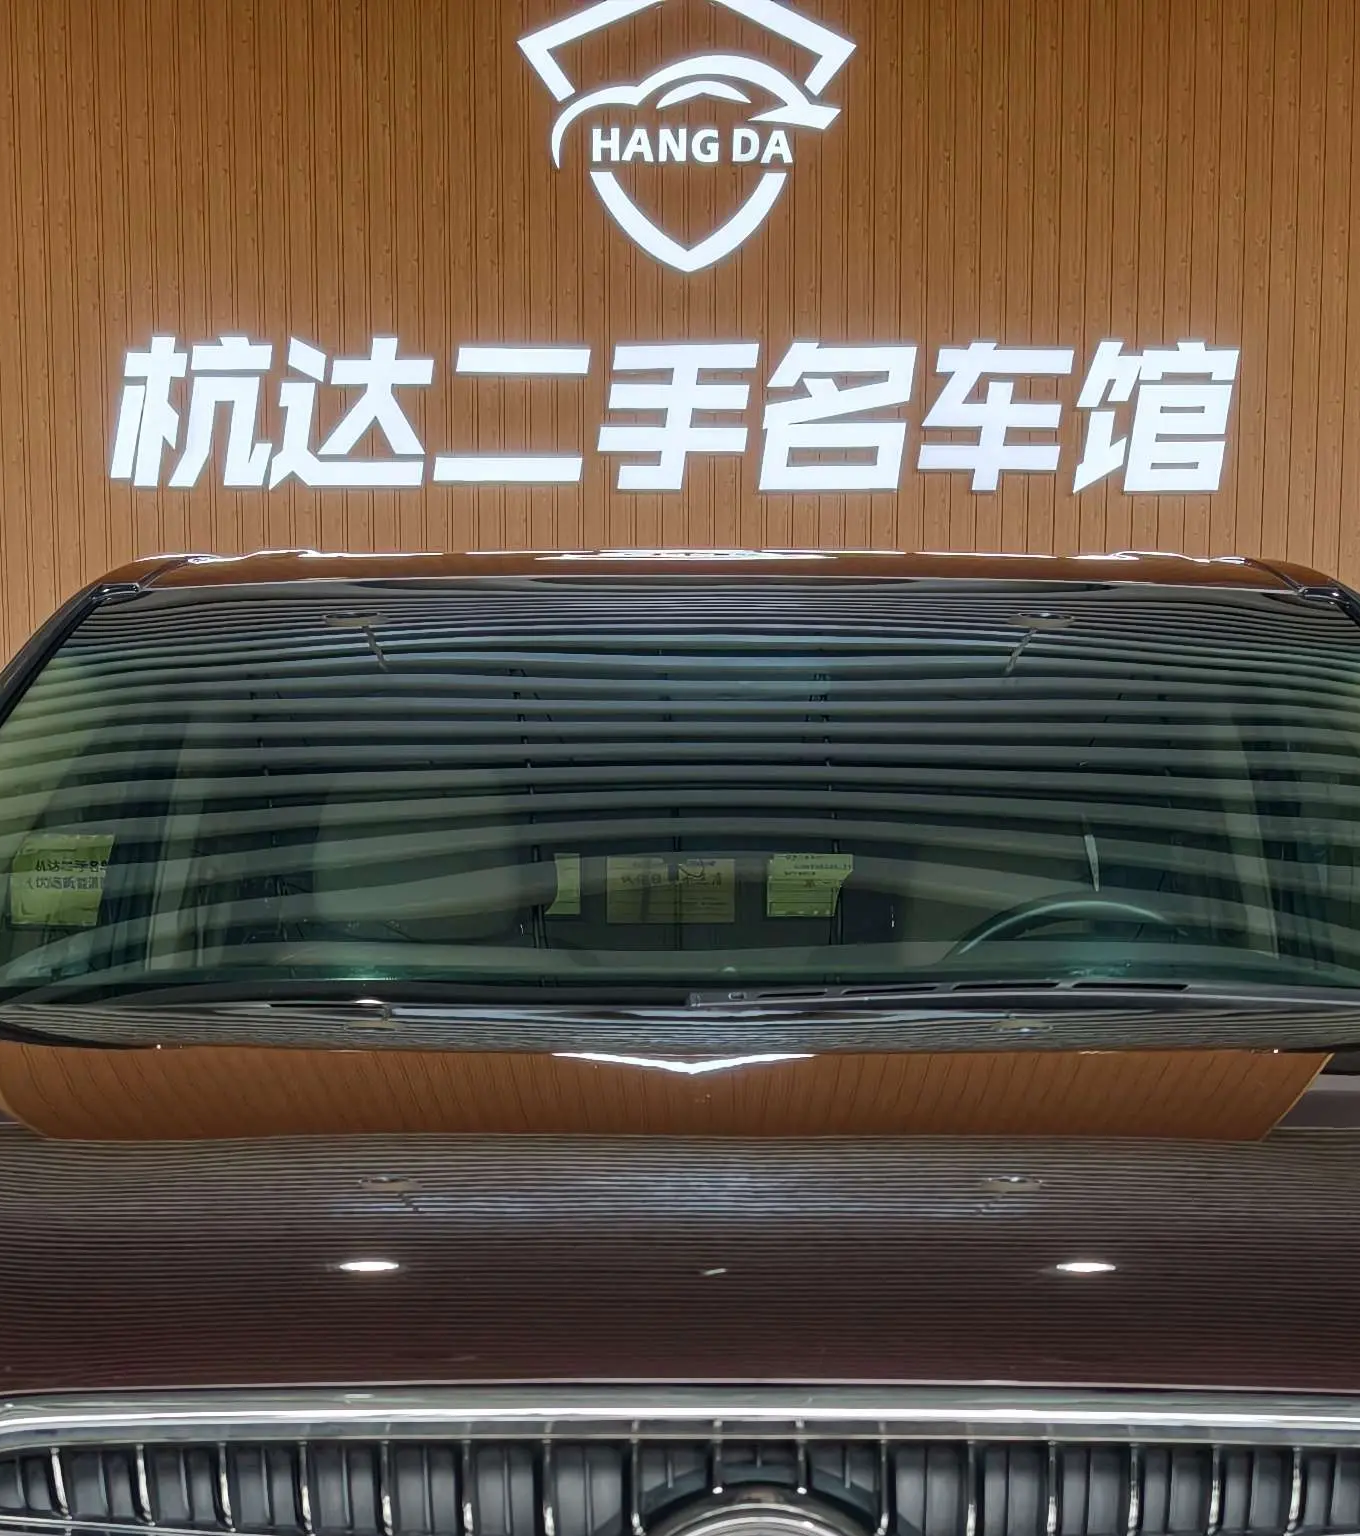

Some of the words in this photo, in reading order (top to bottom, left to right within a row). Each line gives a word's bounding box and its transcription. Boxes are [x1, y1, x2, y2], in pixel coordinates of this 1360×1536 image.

[592, 127, 720, 164] HANG
[732, 128, 793, 164] DA
[110, 336, 1240, 493] 杭达二手名车馆
